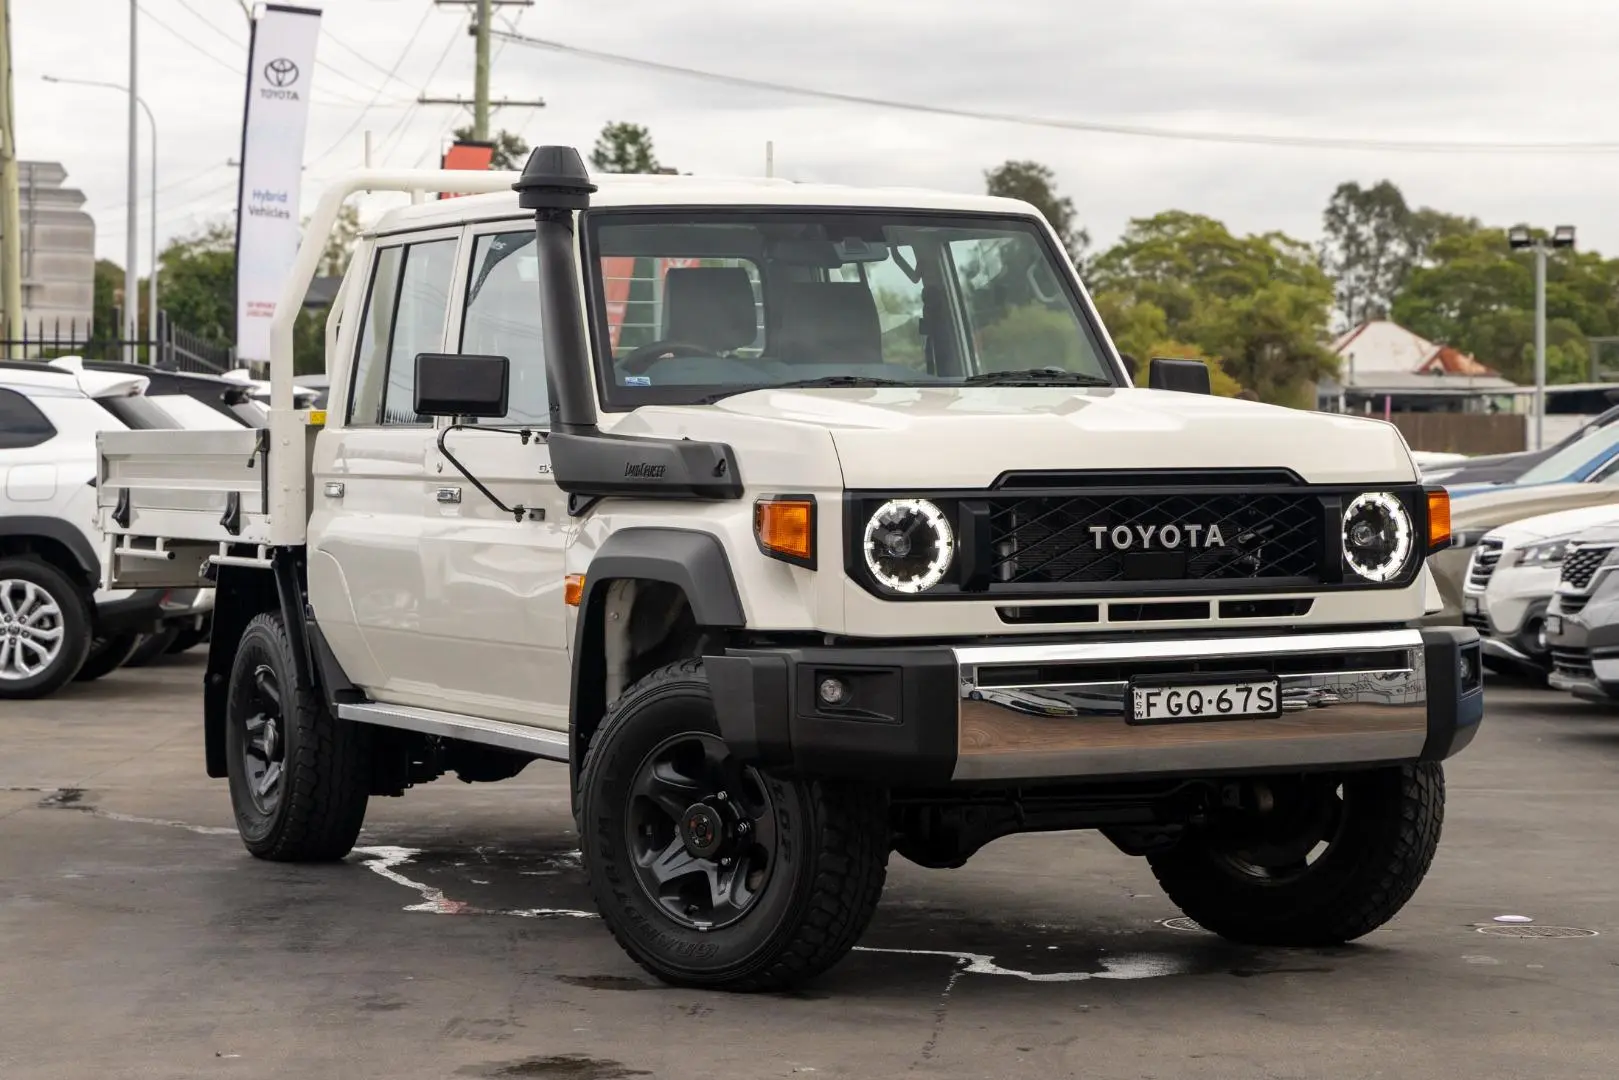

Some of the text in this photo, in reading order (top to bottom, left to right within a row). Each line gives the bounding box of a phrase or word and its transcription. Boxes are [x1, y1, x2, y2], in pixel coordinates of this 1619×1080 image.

[260, 88, 300, 101] TOYOTA
[252, 189, 287, 207] Hybrid
[248, 204, 290, 219] Vehicles
[1089, 524, 1225, 550] TOYOTA
[1135, 692, 1144, 719] NSW
